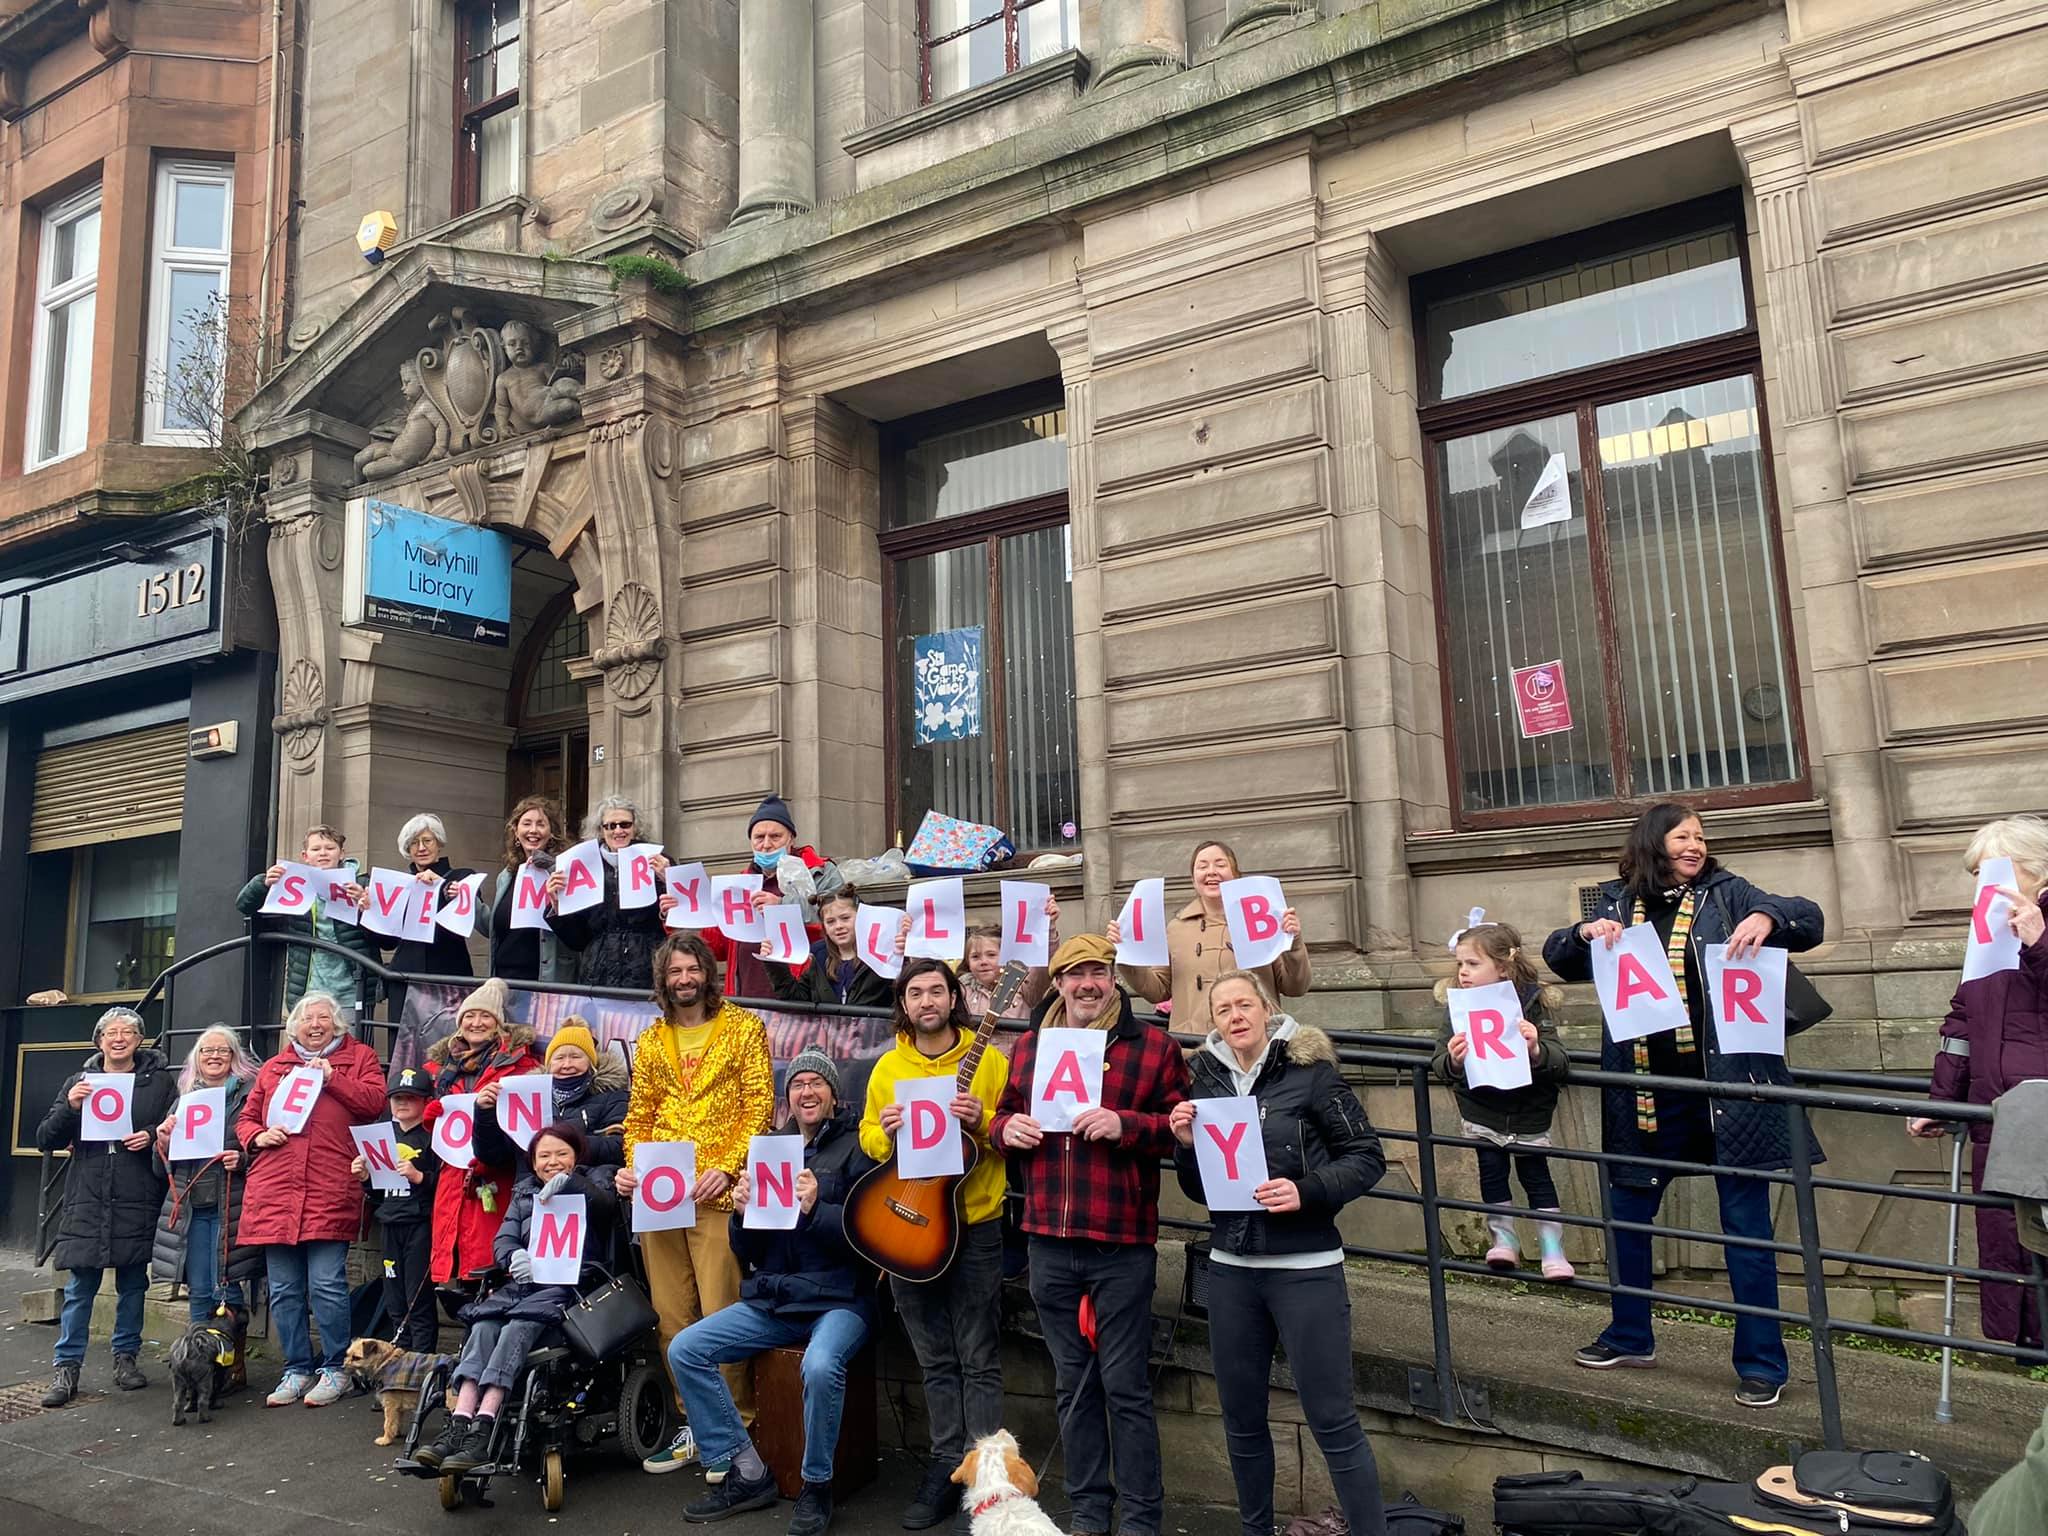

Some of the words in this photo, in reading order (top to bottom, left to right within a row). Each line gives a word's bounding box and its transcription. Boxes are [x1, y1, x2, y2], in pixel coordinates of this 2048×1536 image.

[404, 540, 478, 577] Maryhill
[136, 562, 206, 617] 1512
[409, 570, 474, 606] Library
[280, 876, 306, 907] S
[566, 859, 597, 898] A
[632, 855, 651, 891] R
[330, 883, 355, 908] A
[375, 883, 404, 917] V
[419, 891, 434, 924] E
[455, 883, 471, 916] D
[519, 876, 551, 910] M
[672, 878, 700, 912] Y
[723, 889, 754, 925] H
[924, 898, 949, 939] L
[1016, 900, 1033, 943] L
[1133, 898, 1144, 942] I
[1241, 896, 1278, 942] B
[868, 923, 888, 963] L
[1616, 953, 1668, 1011] A
[1723, 969, 1768, 1024] R
[1469, 1009, 1515, 1060] R
[284, 1078, 314, 1114] E
[1042, 1050, 1090, 1104] A
[91, 1088, 125, 1122] O
[185, 1104, 212, 1140] P
[508, 1093, 544, 1133] N
[441, 1110, 474, 1149] O
[911, 1100, 947, 1150] D
[363, 1139, 399, 1173] N
[1203, 1122, 1249, 1181] Y
[641, 1166, 686, 1213] O
[755, 1161, 794, 1208] N
[536, 1213, 580, 1259] M
